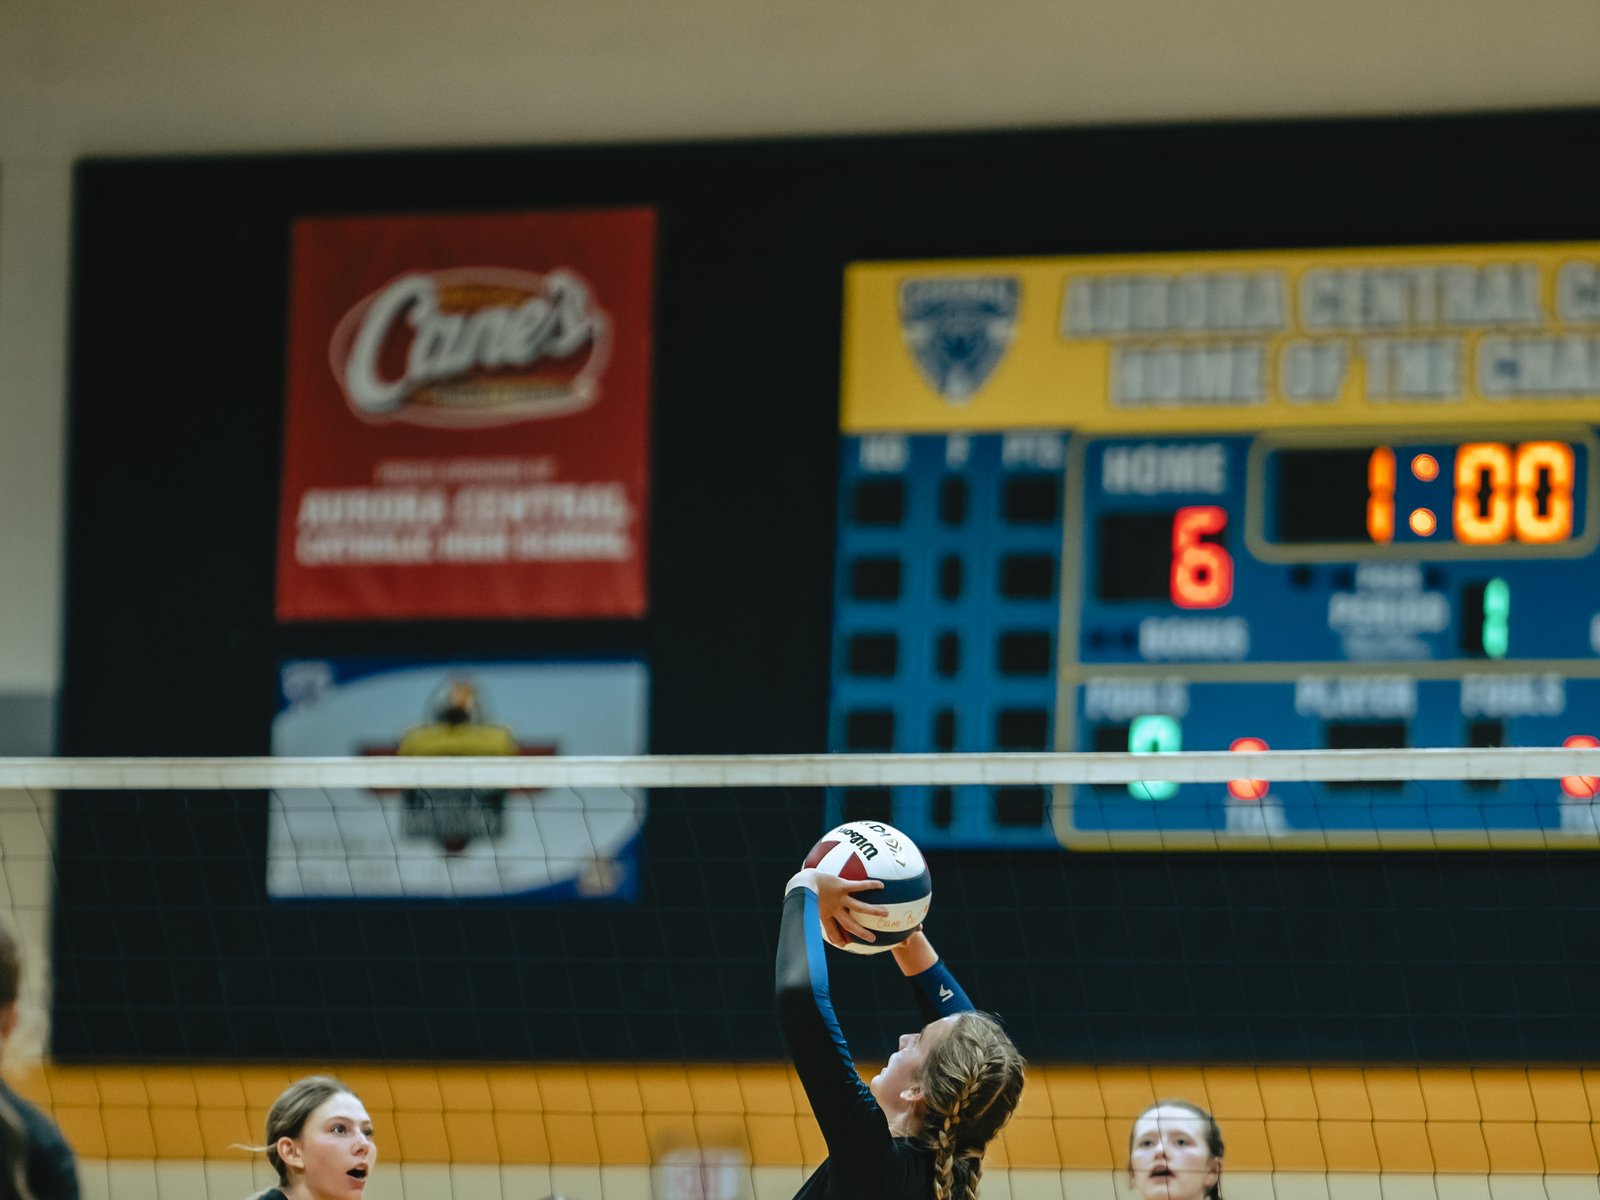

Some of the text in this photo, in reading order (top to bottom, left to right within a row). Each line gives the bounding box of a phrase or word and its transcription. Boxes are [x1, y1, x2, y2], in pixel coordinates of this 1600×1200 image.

[345, 269, 607, 414] Cane's
[1102, 443, 1227, 495] HOME
[1366, 441, 1576, 545] 1:00
[1170, 505, 1234, 609] 6
[1482, 577, 1510, 660] 1
[838, 827, 878, 861] Wilson
